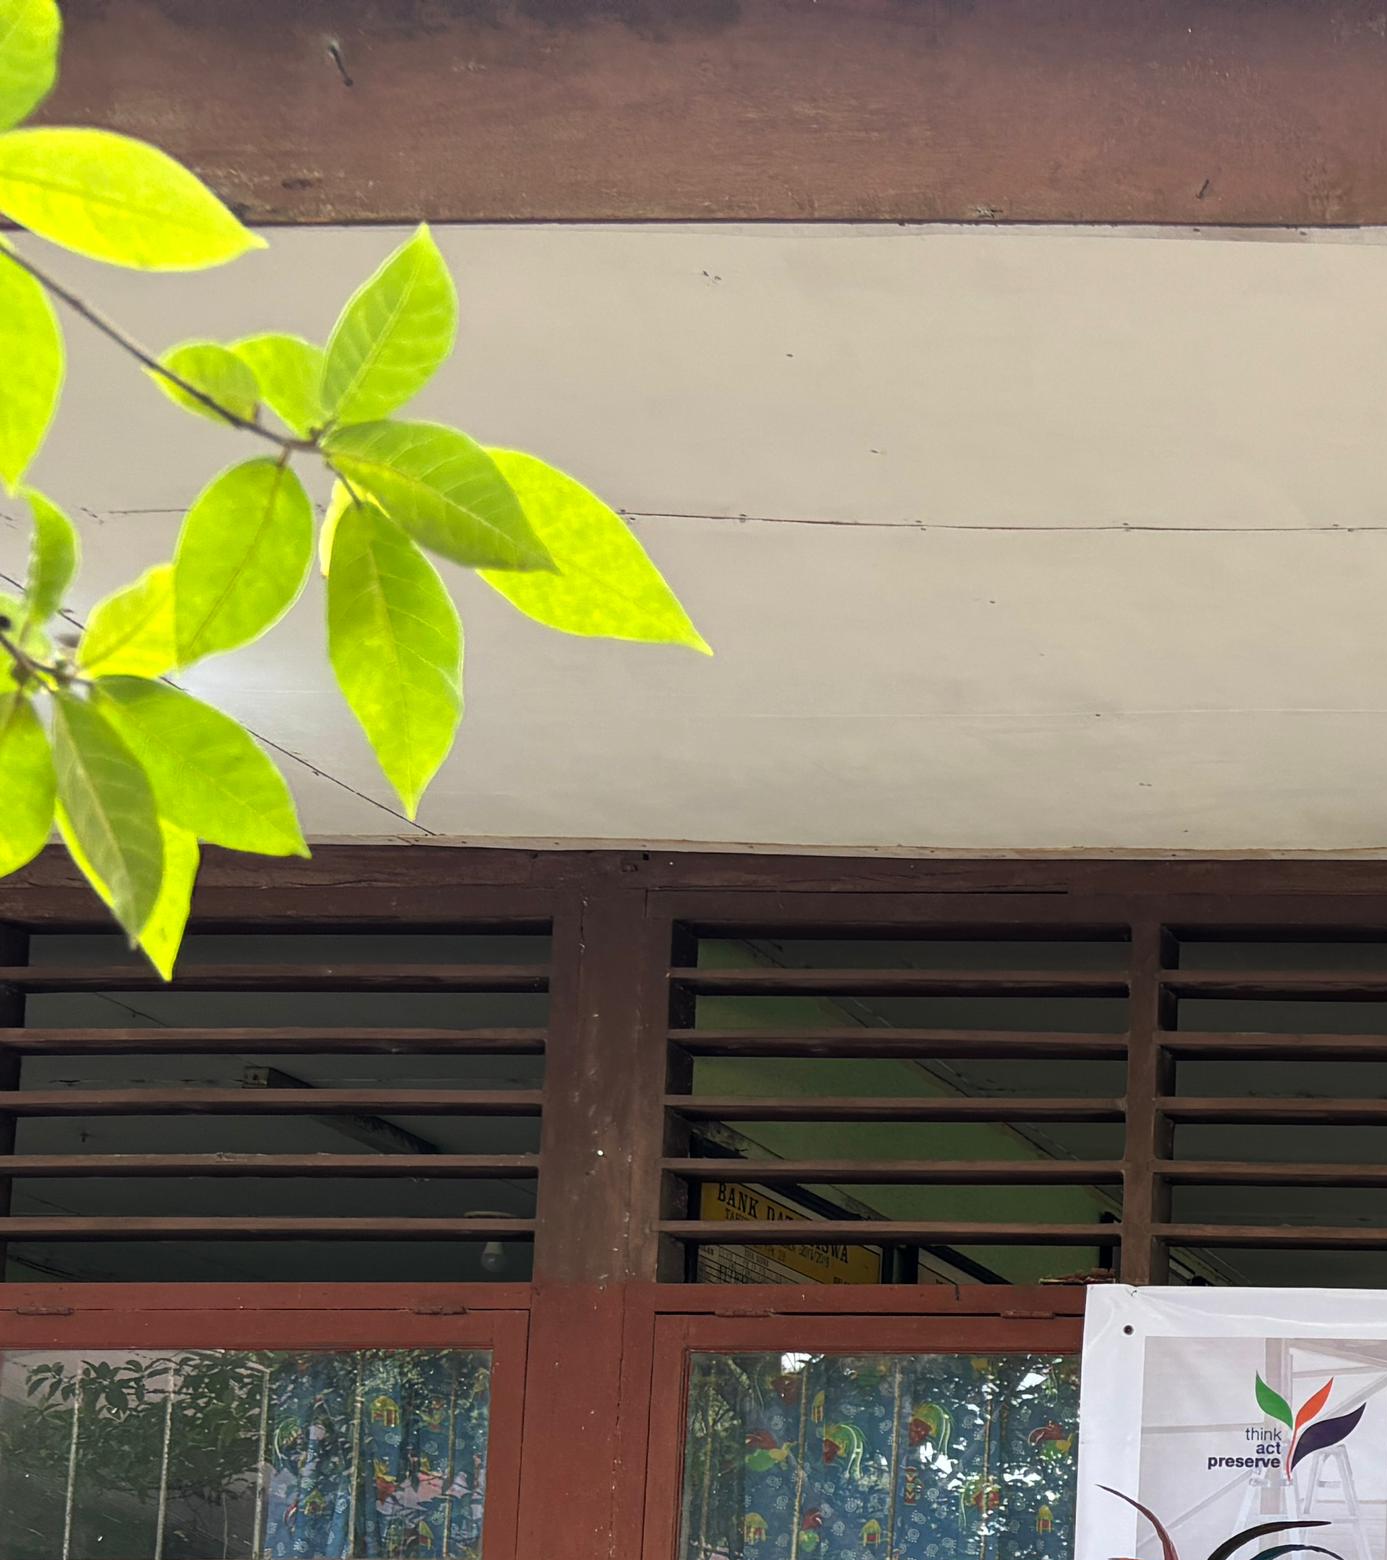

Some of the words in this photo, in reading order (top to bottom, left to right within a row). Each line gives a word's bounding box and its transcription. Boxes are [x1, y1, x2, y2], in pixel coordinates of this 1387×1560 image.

[718, 1182, 759, 1218] BANK
[1245, 1427, 1282, 1441] think
[1256, 1442, 1281, 1455] act
[1208, 1456, 1281, 1469] preserve
